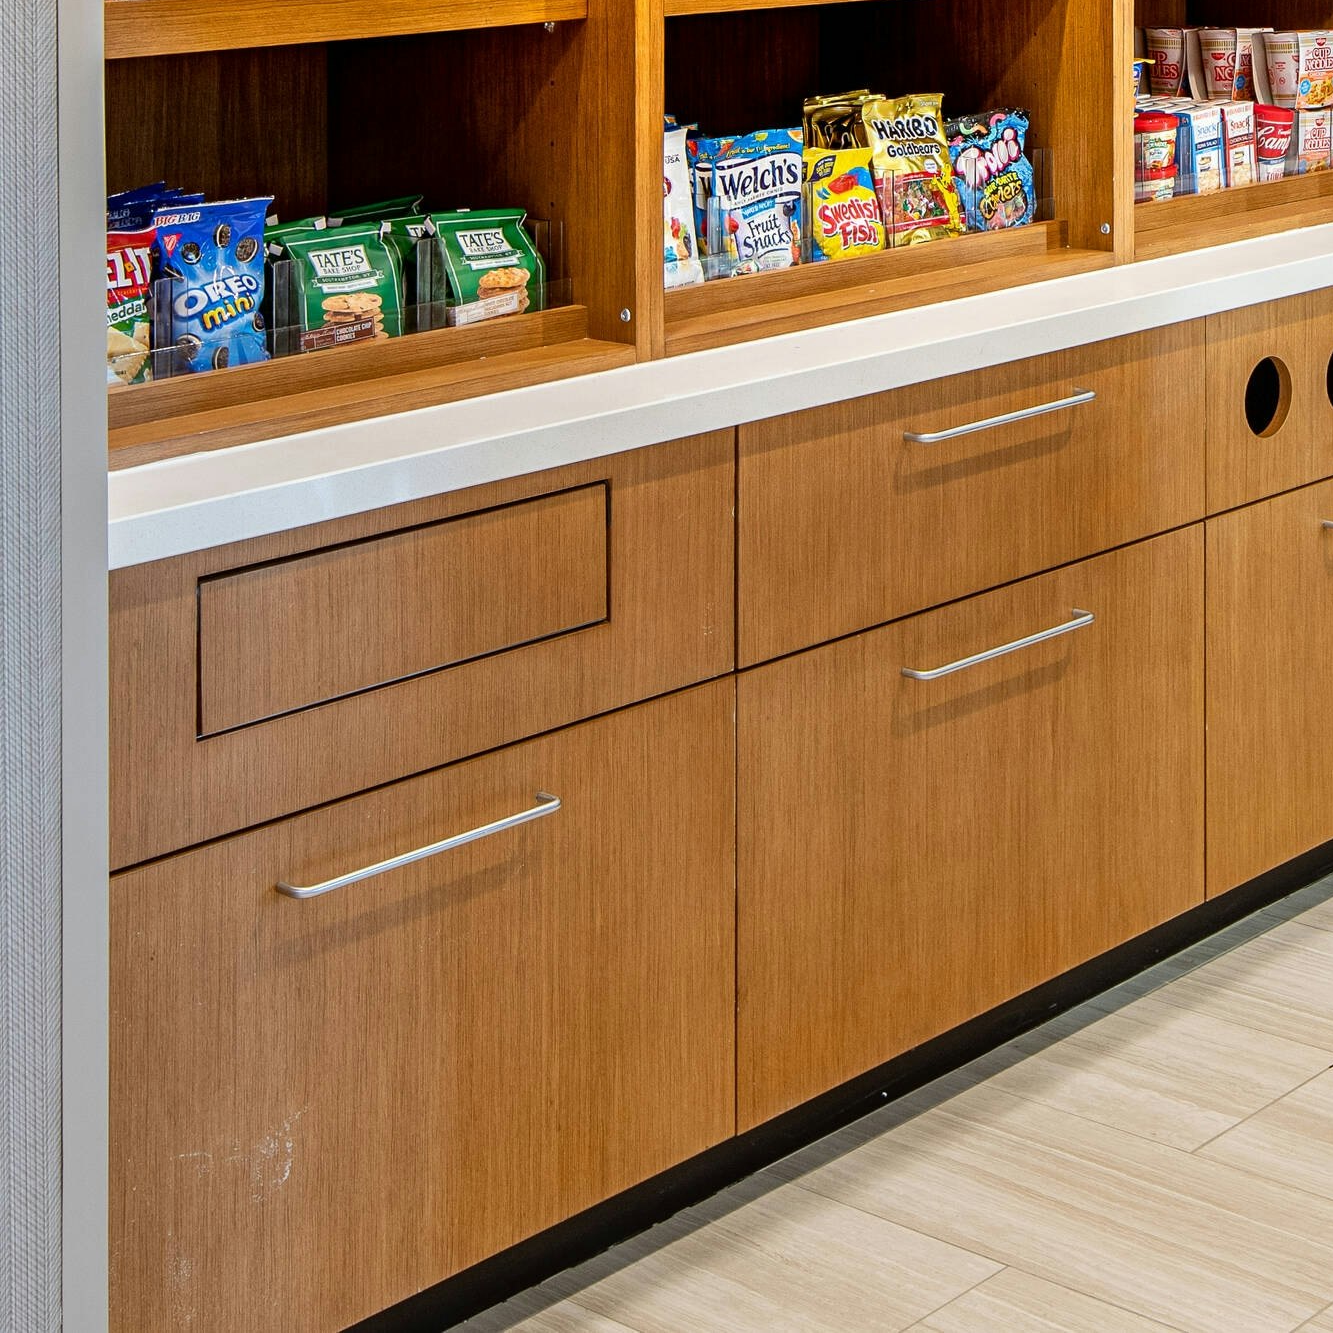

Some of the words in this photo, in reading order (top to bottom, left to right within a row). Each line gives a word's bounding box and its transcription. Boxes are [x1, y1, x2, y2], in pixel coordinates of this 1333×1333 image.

[1312, 48, 1332, 59] CUP
[873, 115, 938, 142] HARIBO
[1230, 116, 1251, 131] Snack
[1310, 128, 1327, 139] CUP
[887, 142, 942, 159] Goldbears
[955, 127, 1022, 188] Trolli
[1302, 138, 1332, 151] NOODLES
[718, 158, 798, 200] Welch's
[748, 213, 783, 240] Fruit
[818, 195, 880, 236] Swedish
[459, 229, 505, 248] TATE'S
[743, 229, 792, 258] Snacks
[839, 216, 878, 250] Fish
[312, 248, 365, 269] TATE'S
[174, 275, 258, 317] OREO
[202, 294, 255, 330] mini
